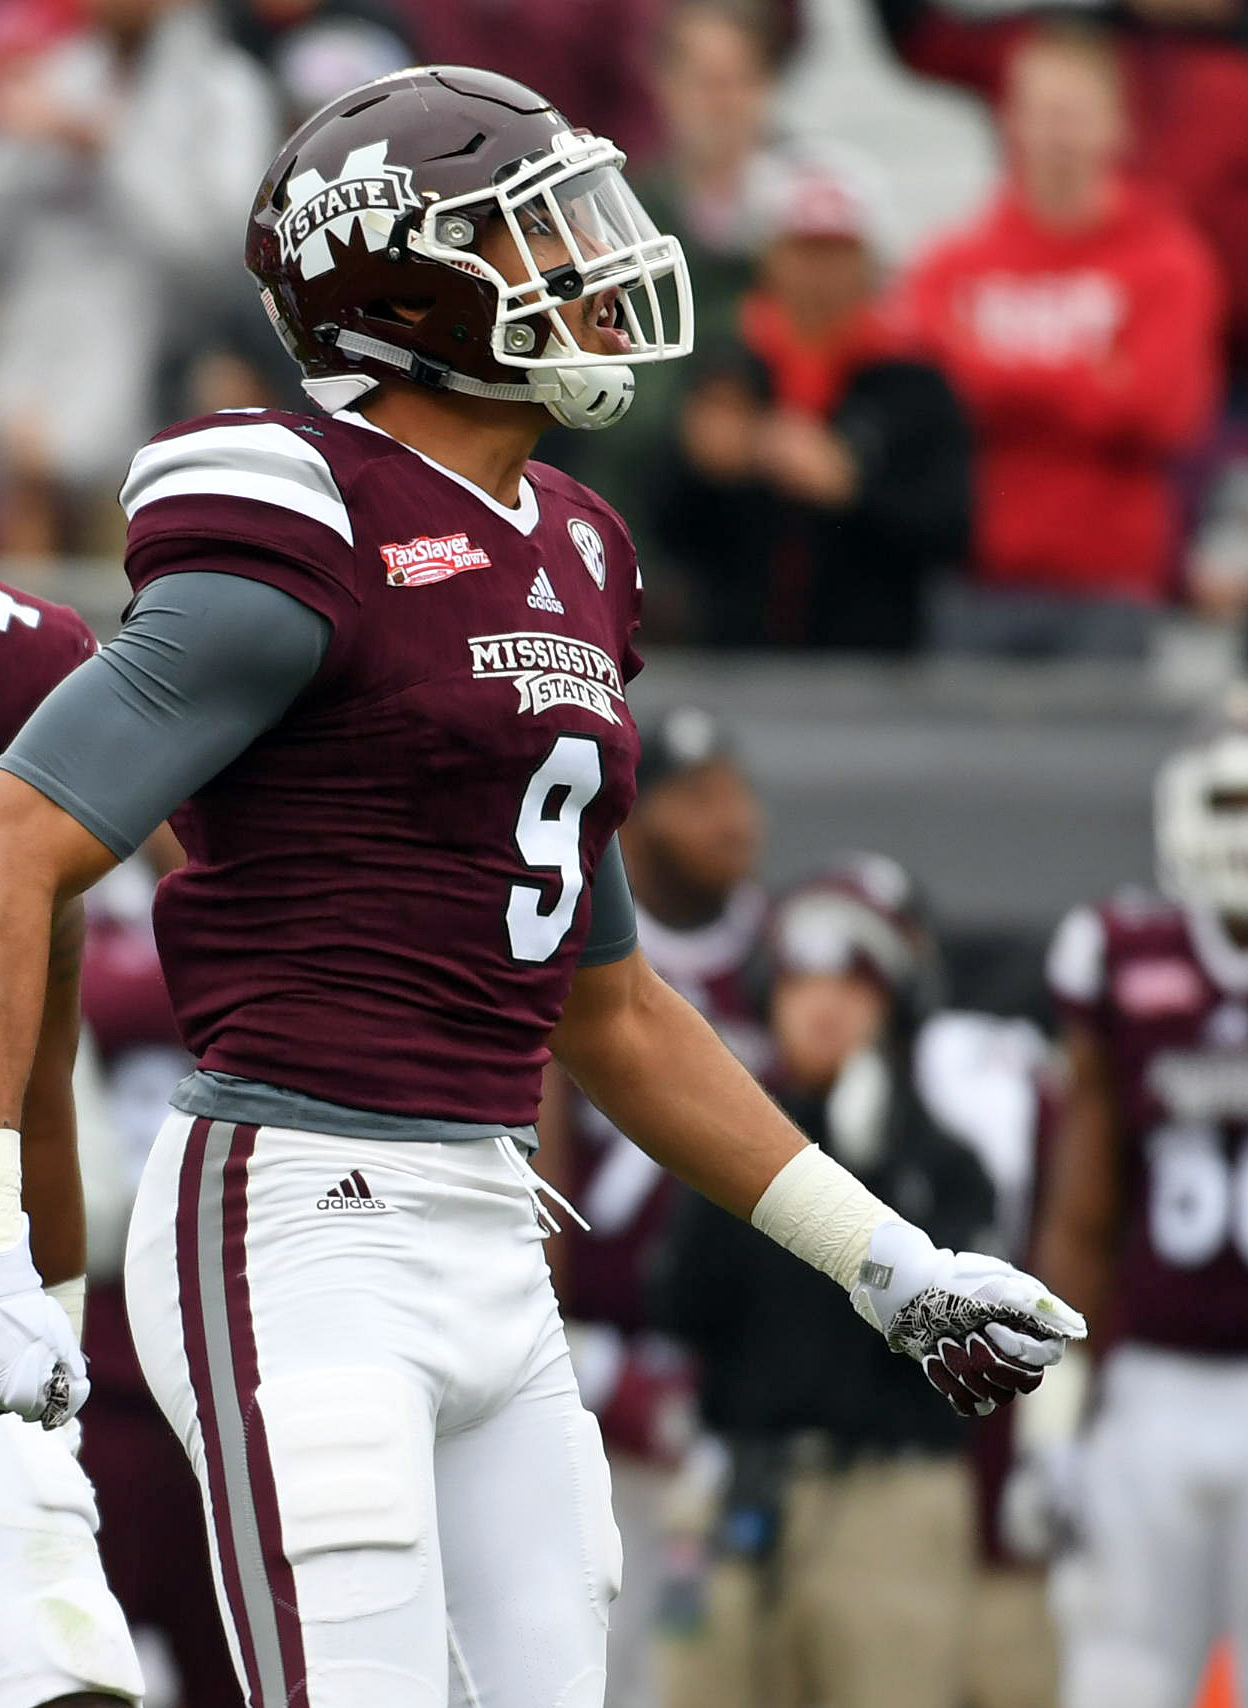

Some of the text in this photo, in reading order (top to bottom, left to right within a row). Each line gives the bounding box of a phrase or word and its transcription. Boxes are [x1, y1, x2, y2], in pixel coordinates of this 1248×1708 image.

[295, 181, 390, 240] STATE
[383, 537, 490, 568] TaxSlayer BOWL
[527, 595, 565, 615] adidas
[539, 678, 603, 712] STATE
[504, 731, 602, 965] 9
[316, 1196, 386, 1210] adidas
